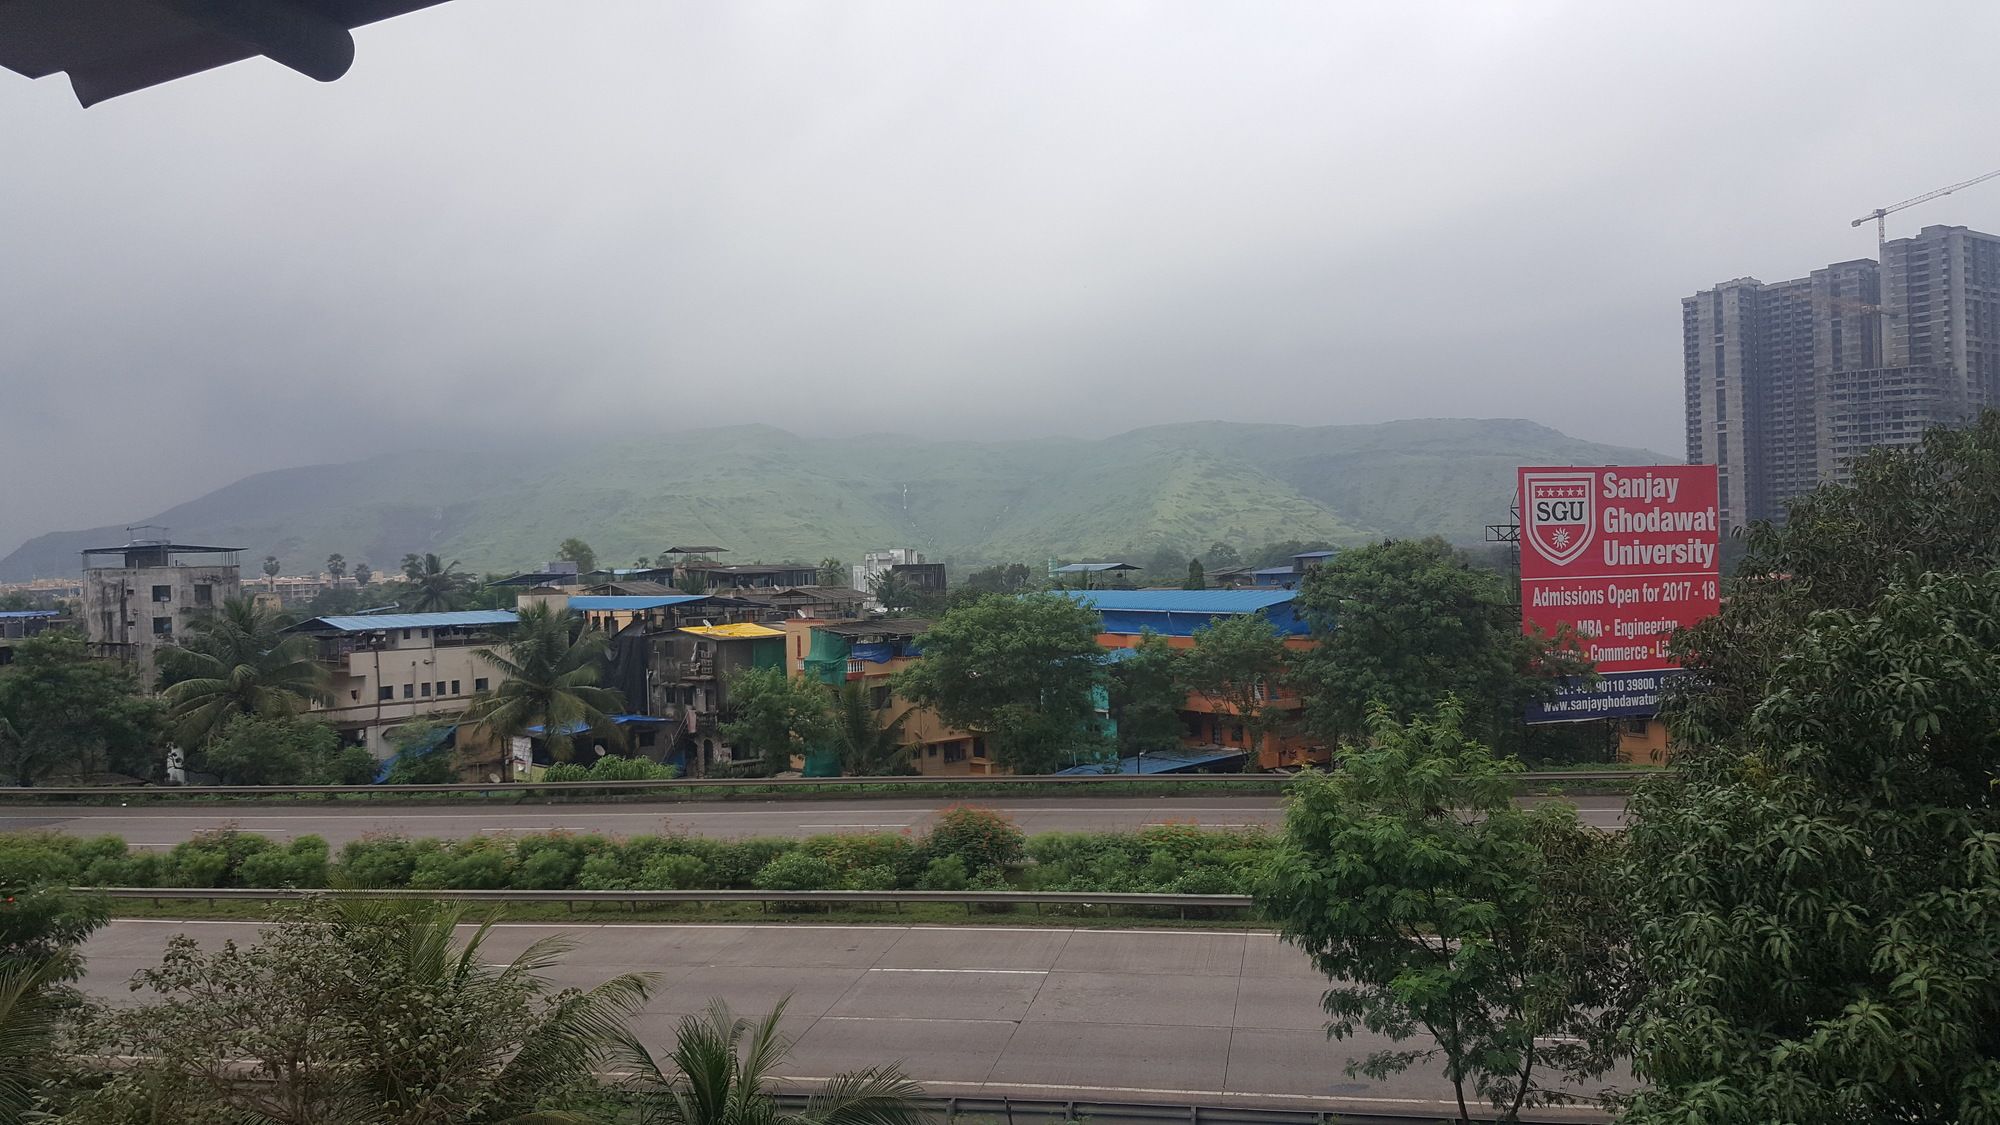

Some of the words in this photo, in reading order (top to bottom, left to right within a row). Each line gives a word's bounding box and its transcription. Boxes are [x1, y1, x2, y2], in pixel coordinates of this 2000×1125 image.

[1602, 472, 1679, 503] Sanjay
[1536, 501, 1585, 521] SGU
[1603, 507, 1716, 533] Ghodawat
[1603, 538, 1716, 568] University
[1533, 586, 1604, 607] Admissions
[1607, 584, 1639, 608] Open
[1642, 583, 1660, 602] for
[1663, 581, 1691, 602] 2017
[1701, 581, 1716, 600] 18
[1577, 619, 1603, 637] MBA
[1590, 644, 1648, 662] Commerce
[1595, 680, 1624, 694] 90110
[1626, 678, 1658, 692] 39800,
